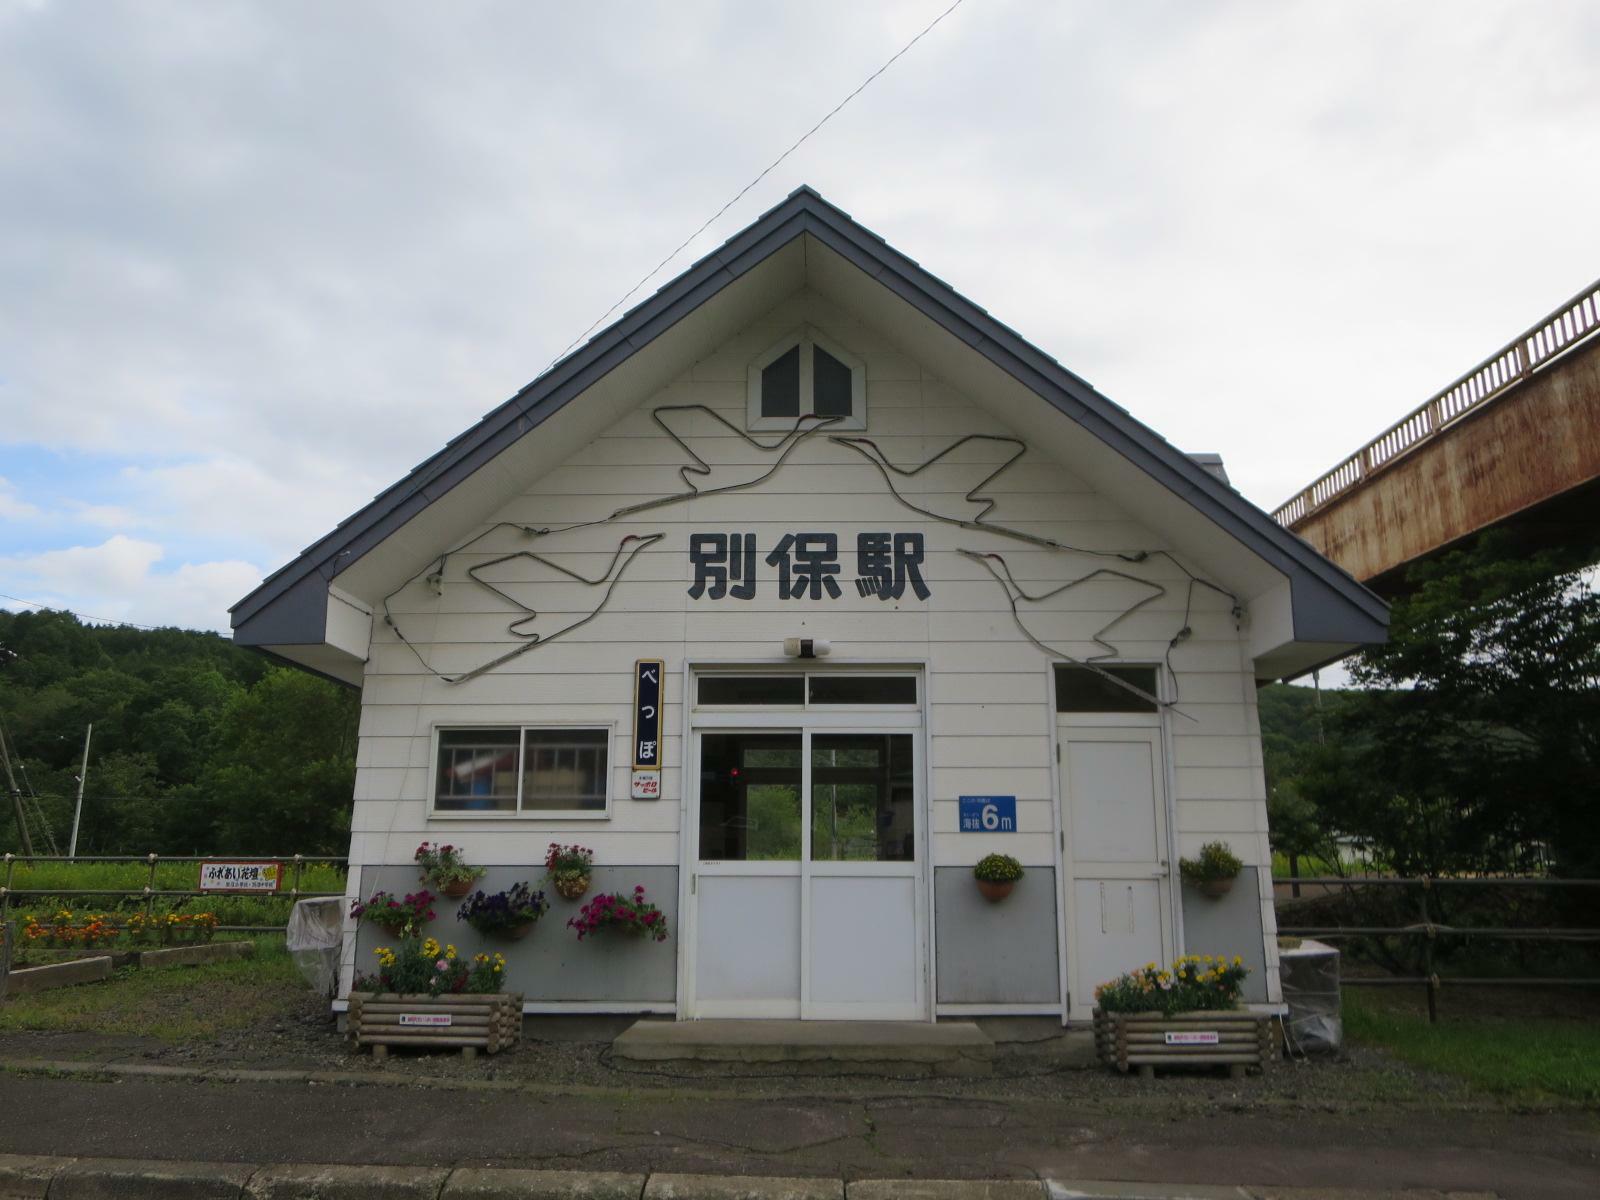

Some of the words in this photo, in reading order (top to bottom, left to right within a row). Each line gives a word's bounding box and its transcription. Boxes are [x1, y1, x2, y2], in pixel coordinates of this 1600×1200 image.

[687, 532, 931, 601] 別保駅
[208, 867, 259, 880] ふれあい花壇
